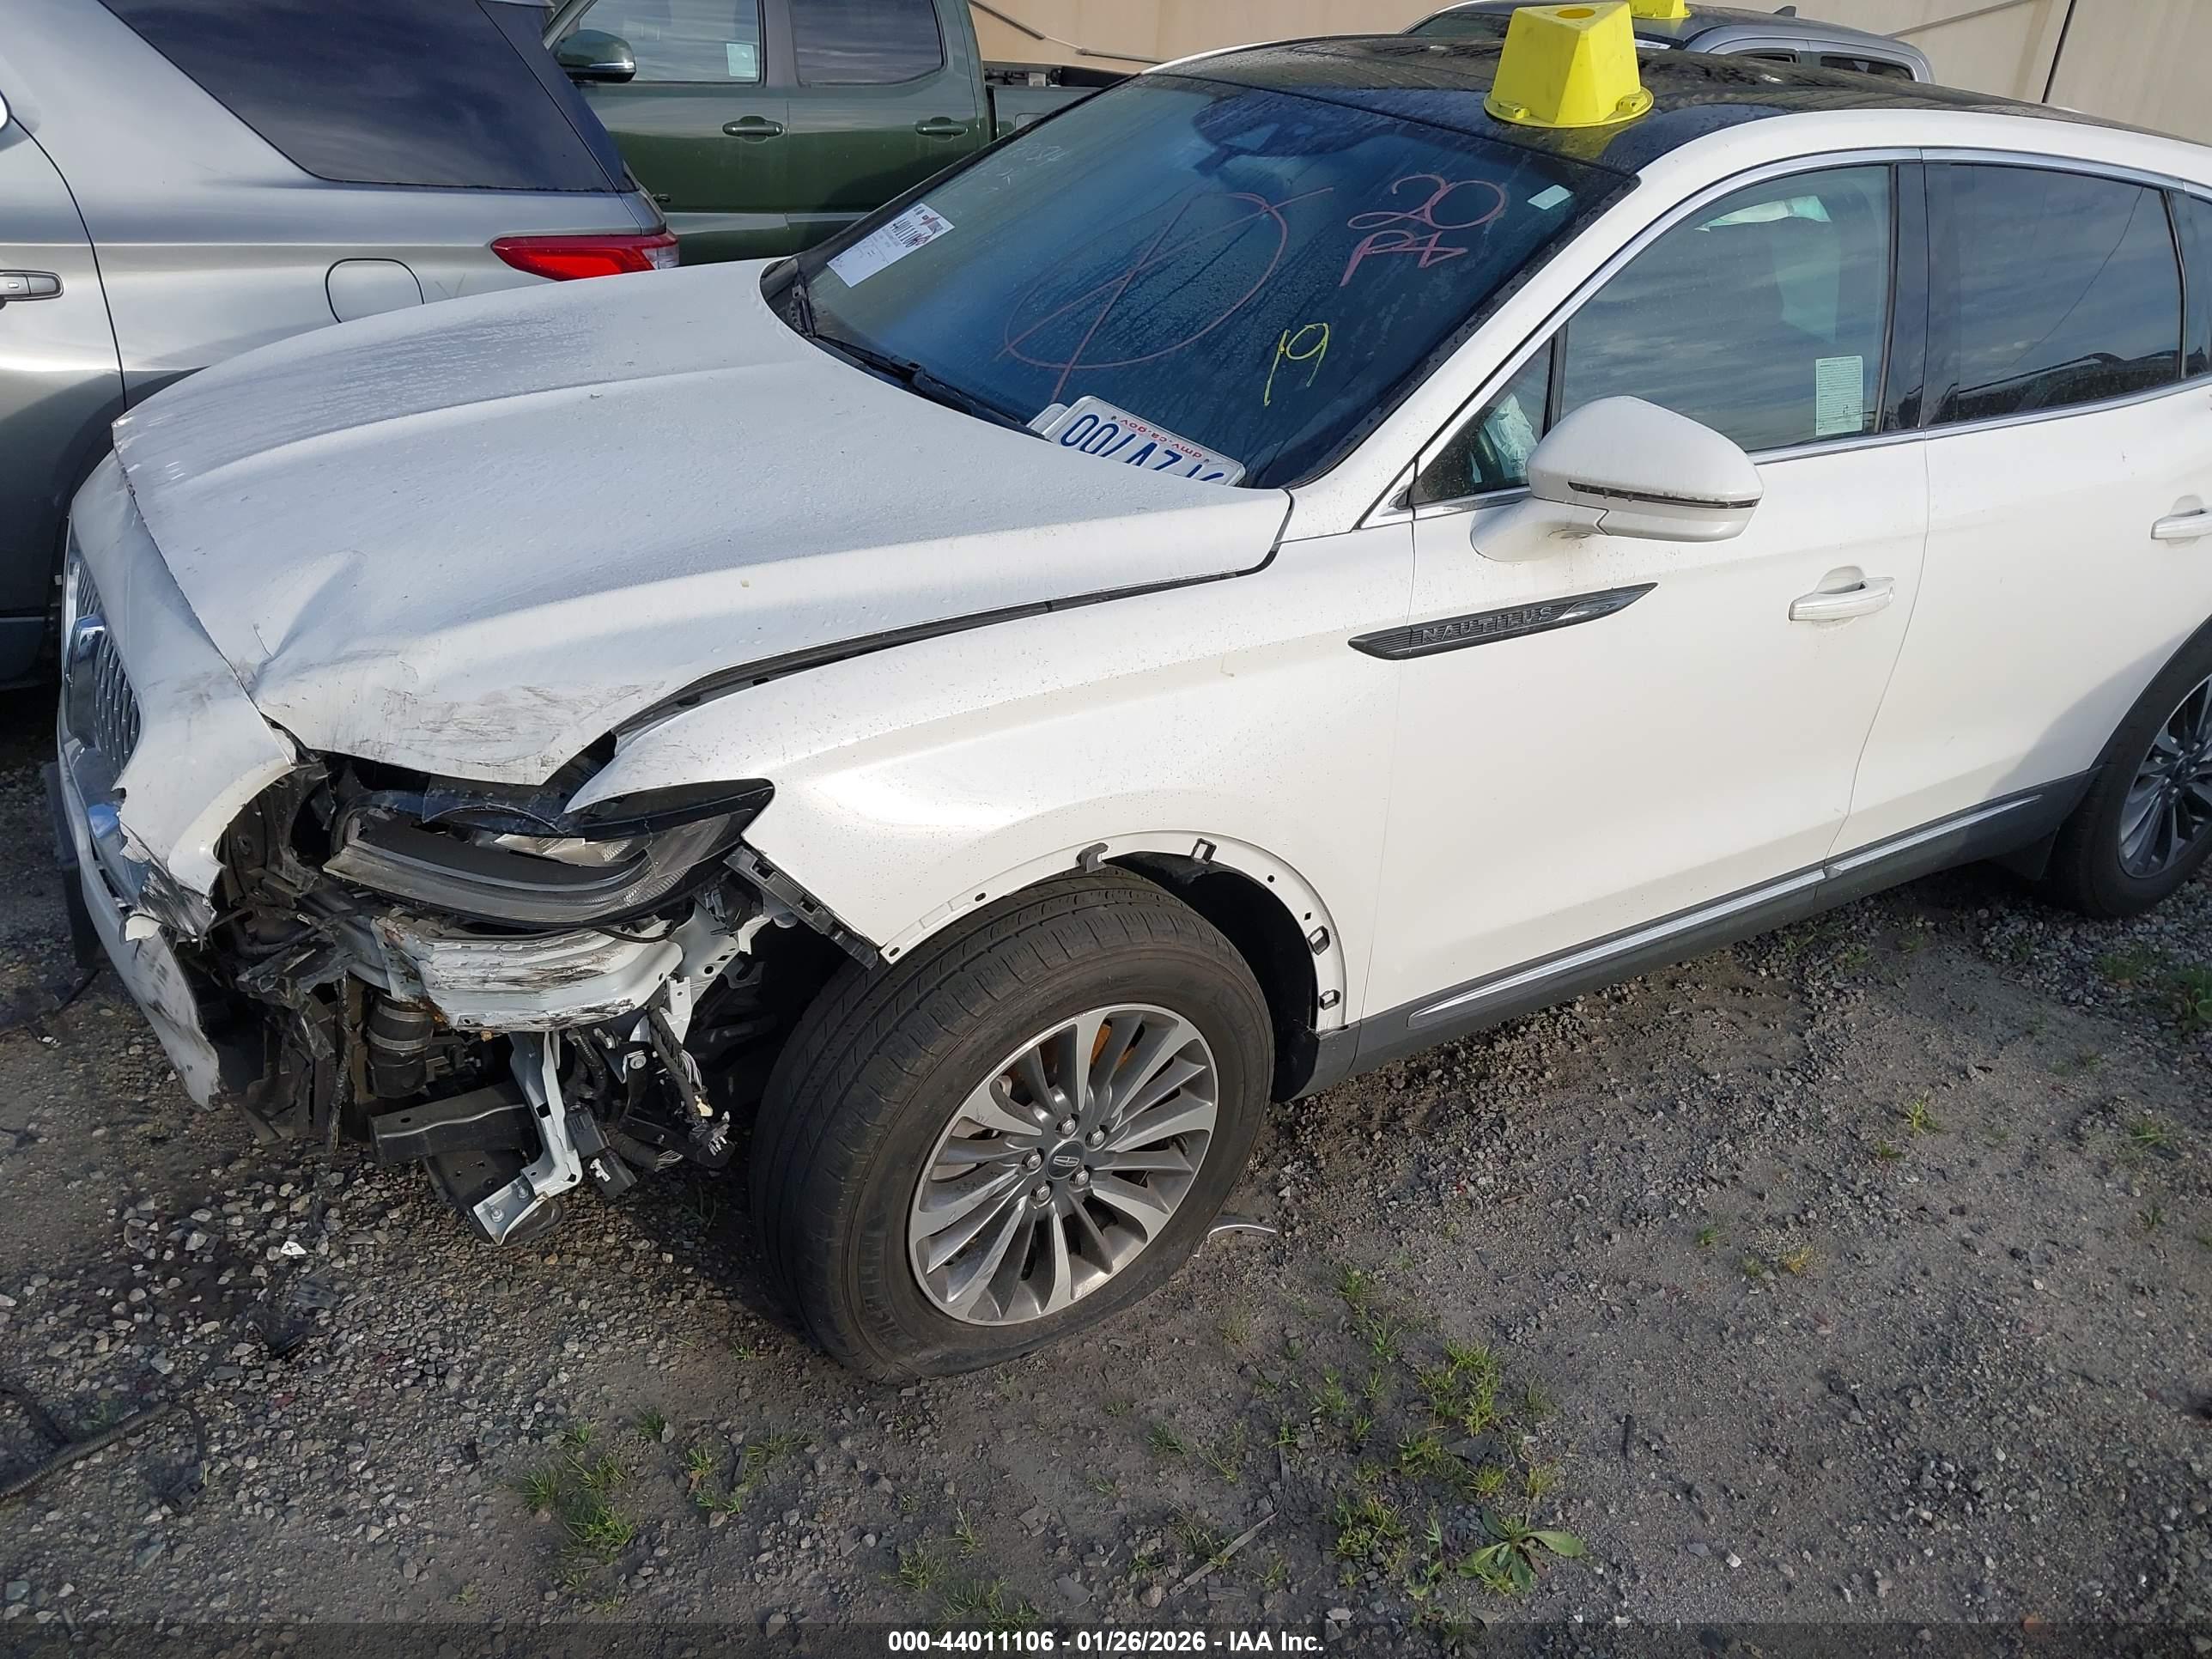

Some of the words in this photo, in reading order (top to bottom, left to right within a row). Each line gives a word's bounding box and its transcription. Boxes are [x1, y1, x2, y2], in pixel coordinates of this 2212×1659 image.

[1347, 174, 1506, 230] 20
[1263, 323, 1330, 406] 19
[1120, 418, 1203, 459] dmv.ca.gov
[1421, 606, 1553, 645] NAUTILUS
